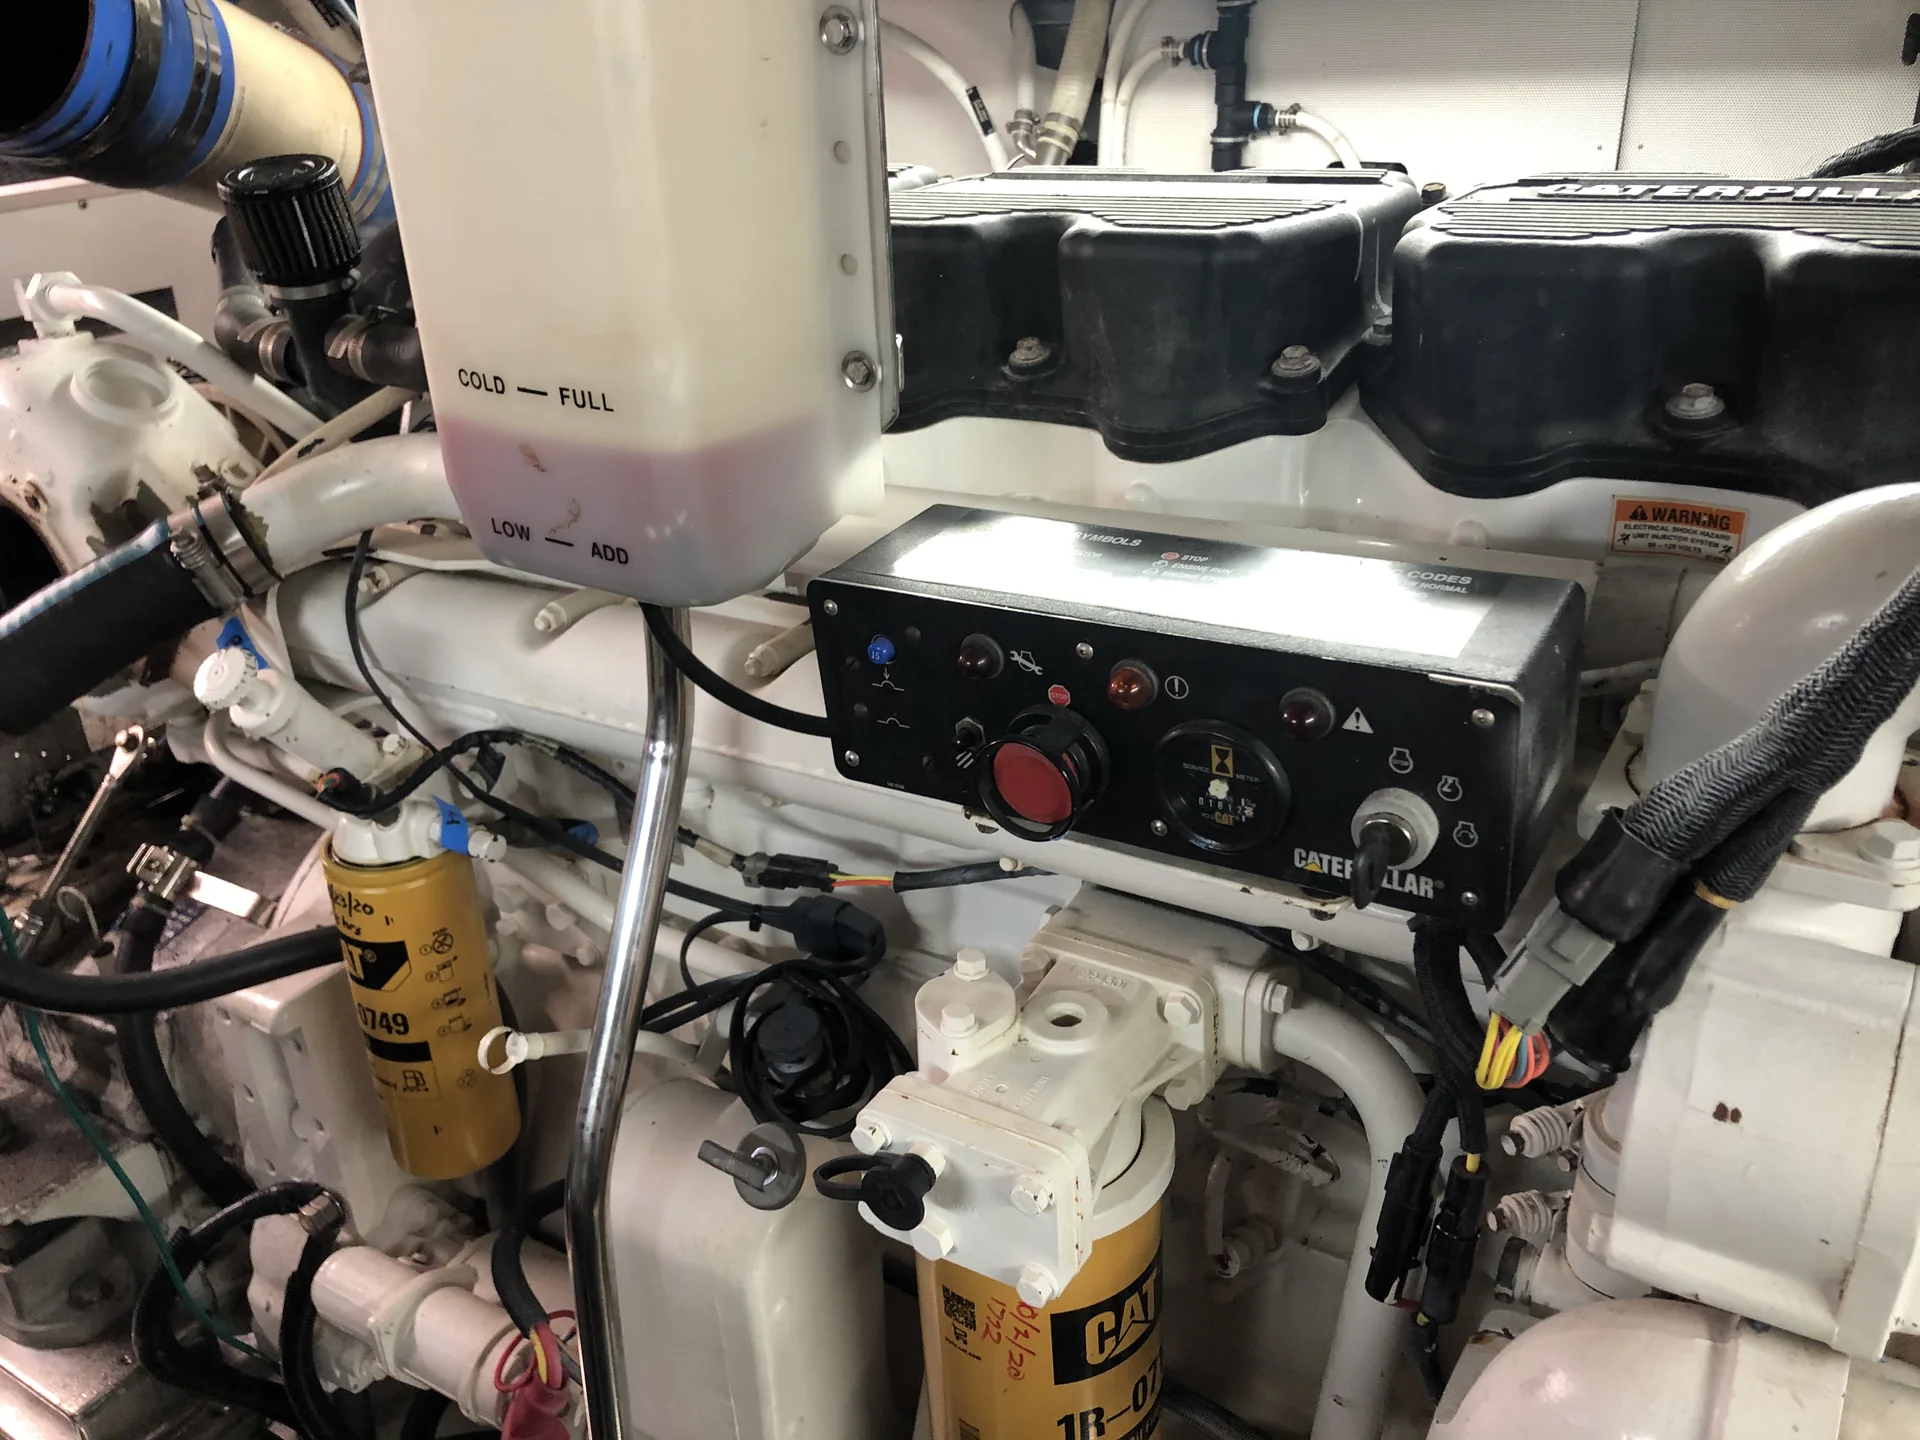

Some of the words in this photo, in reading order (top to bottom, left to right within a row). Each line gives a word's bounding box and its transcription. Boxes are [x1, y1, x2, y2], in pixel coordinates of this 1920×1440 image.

[458, 368, 505, 394] COLD
[559, 387, 614, 412] FULL
[1652, 507, 1730, 530] WARNING
[1624, 523, 1669, 532] ELECTRICAL
[1672, 527, 1697, 535] SHOCK
[1700, 531, 1731, 540] HAZARD
[491, 518, 530, 541] LOW
[591, 542, 629, 565] ADD
[1074, 532, 1142, 547] SYMBOLS
[1651, 533, 1689, 542] INJECTOR
[1690, 538, 1719, 548] SYSTEM
[1171, 563, 1208, 572] ENGINE
[1210, 567, 1234, 575] RUN
[1408, 571, 1472, 584] CODES
[1420, 583, 1467, 593] NORMAL
[871, 650, 880, 660] 15
[1182, 762, 1211, 773] SERVICE
[1235, 773, 1260, 782] METER
[357, 1002, 410, 1036] 0749
[1085, 1267, 1157, 1366] CAT
